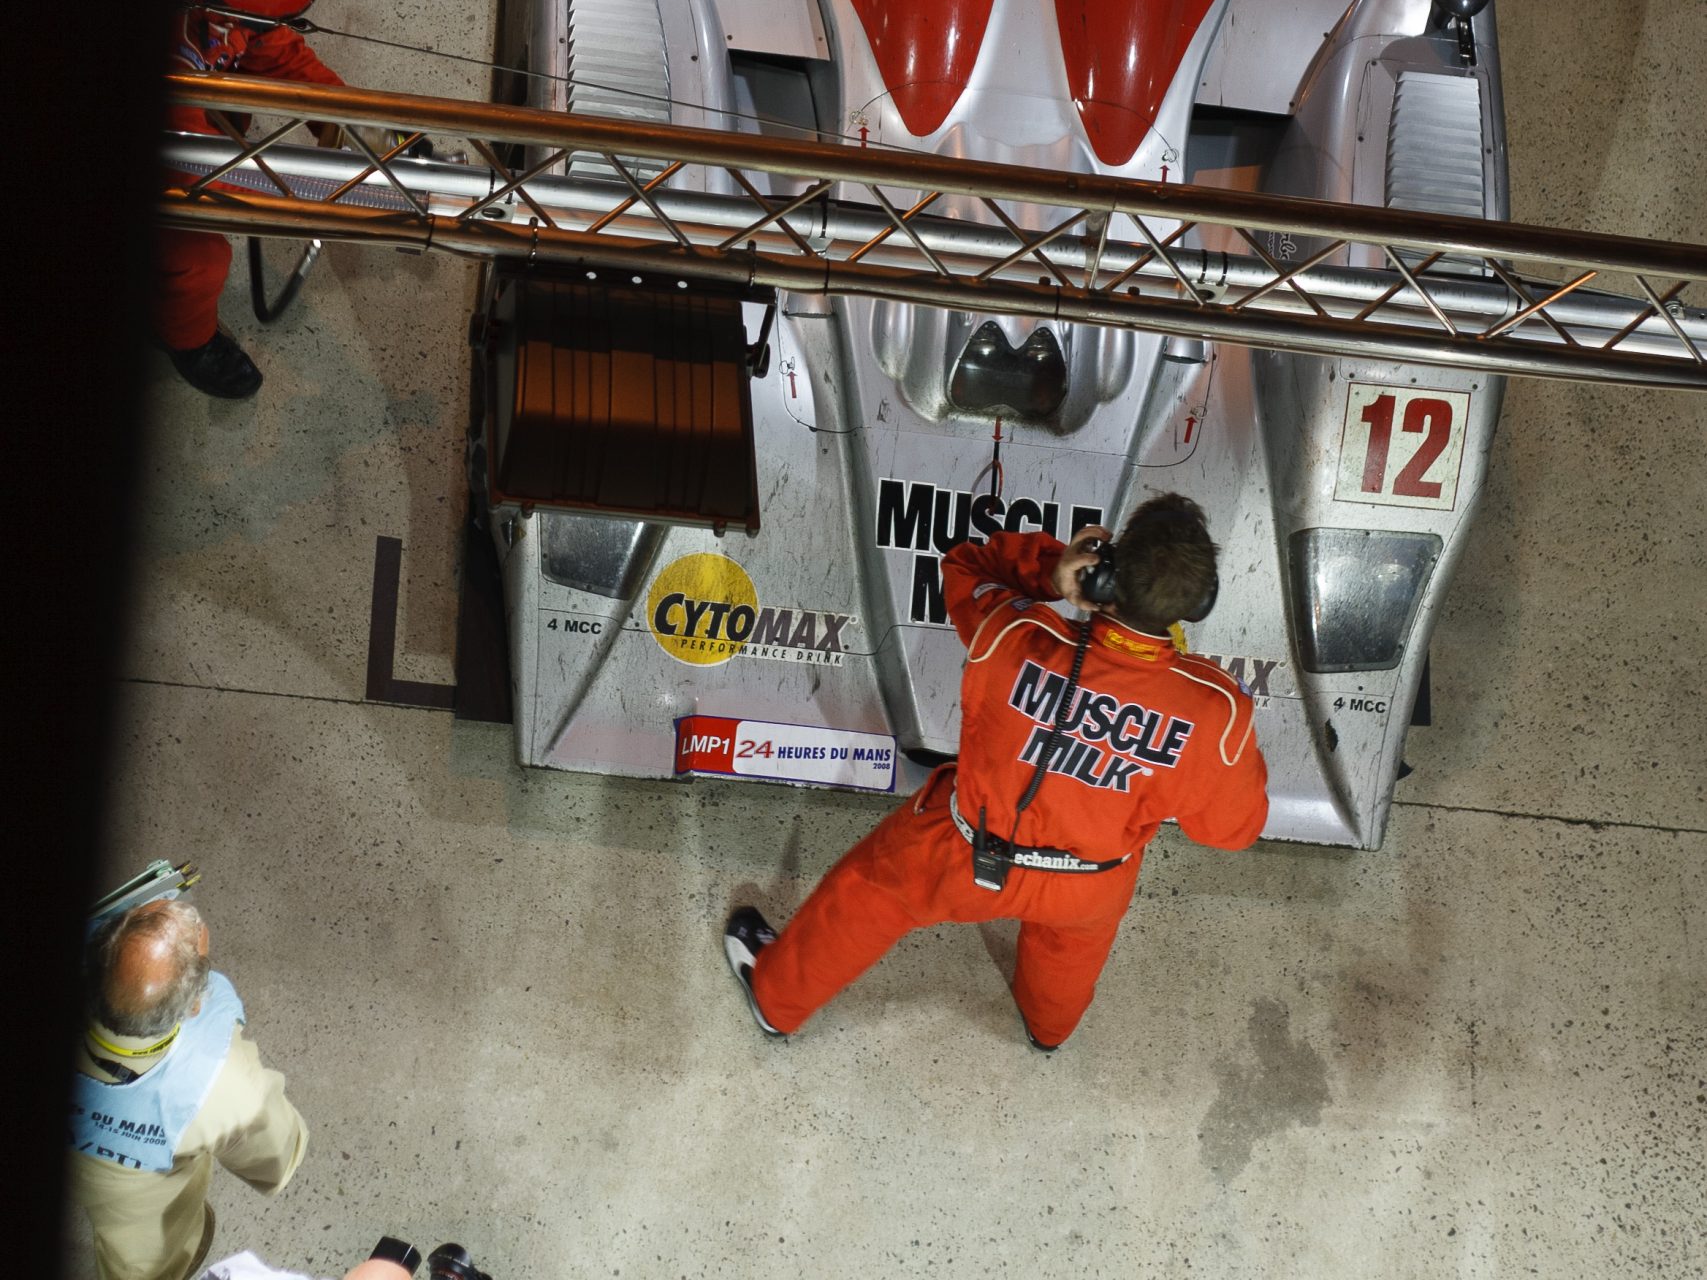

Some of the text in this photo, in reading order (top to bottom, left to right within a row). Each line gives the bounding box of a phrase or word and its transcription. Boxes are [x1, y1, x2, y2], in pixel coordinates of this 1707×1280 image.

[1361, 394, 1453, 499] 12
[547, 618, 602, 635] 4 MCC
[655, 593, 850, 653] CYTOMAX
[681, 639, 787, 659] PERFORMANCE
[797, 651, 842, 665] DRINK
[1009, 659, 1195, 768] MUSCLE
[1334, 696, 1387, 714] 4 MCC
[681, 734, 731, 756] LMP1
[736, 740, 891, 762] 24 HEURES DU MANS
[873, 762, 891, 770] 2008
[1018, 725, 1143, 793] MILK
[1013, 851, 1099, 871] echanix.com
[91, 1111, 114, 1126] DU
